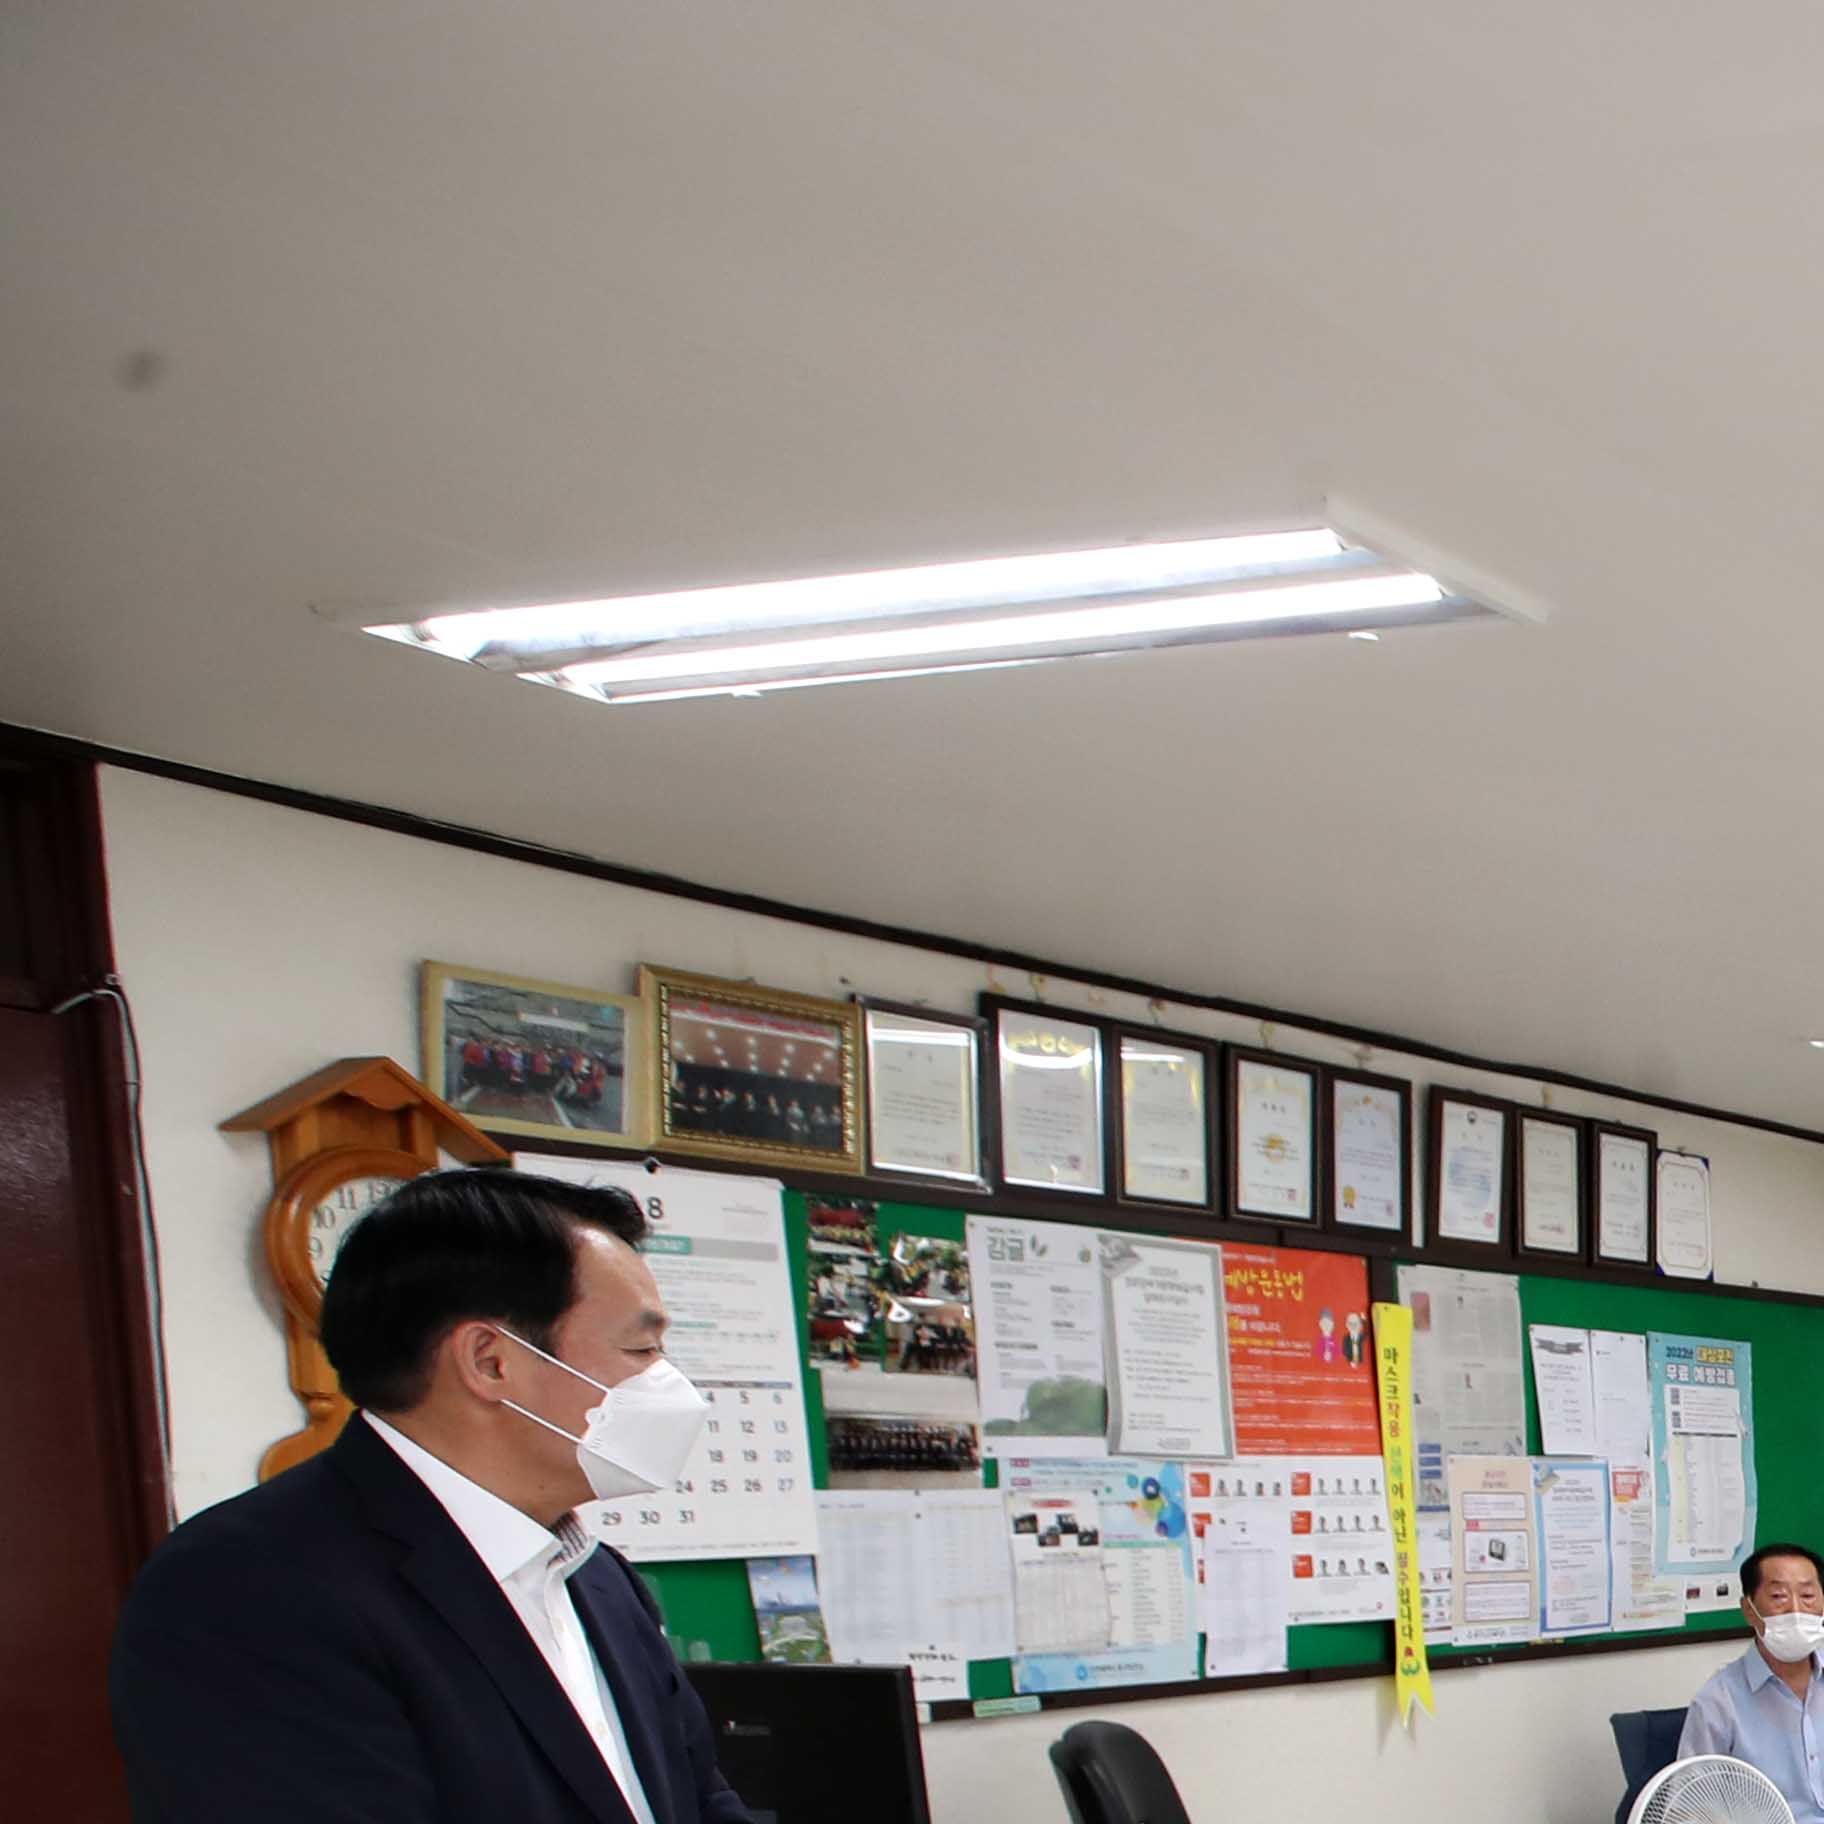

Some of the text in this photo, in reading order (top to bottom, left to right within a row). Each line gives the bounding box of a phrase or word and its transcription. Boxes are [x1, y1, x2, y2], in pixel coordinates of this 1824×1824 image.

[648, 1196, 664, 1220] 8
[739, 1391, 750, 1405] 5
[1382, 1346, 1401, 1439] 마스크착용
[708, 1420, 788, 1434] 11 12 13
[709, 1449, 793, 1463] 18 19 20
[675, 1478, 794, 1494] 24 25 26 27
[602, 1510, 695, 1526] 29 30 31
